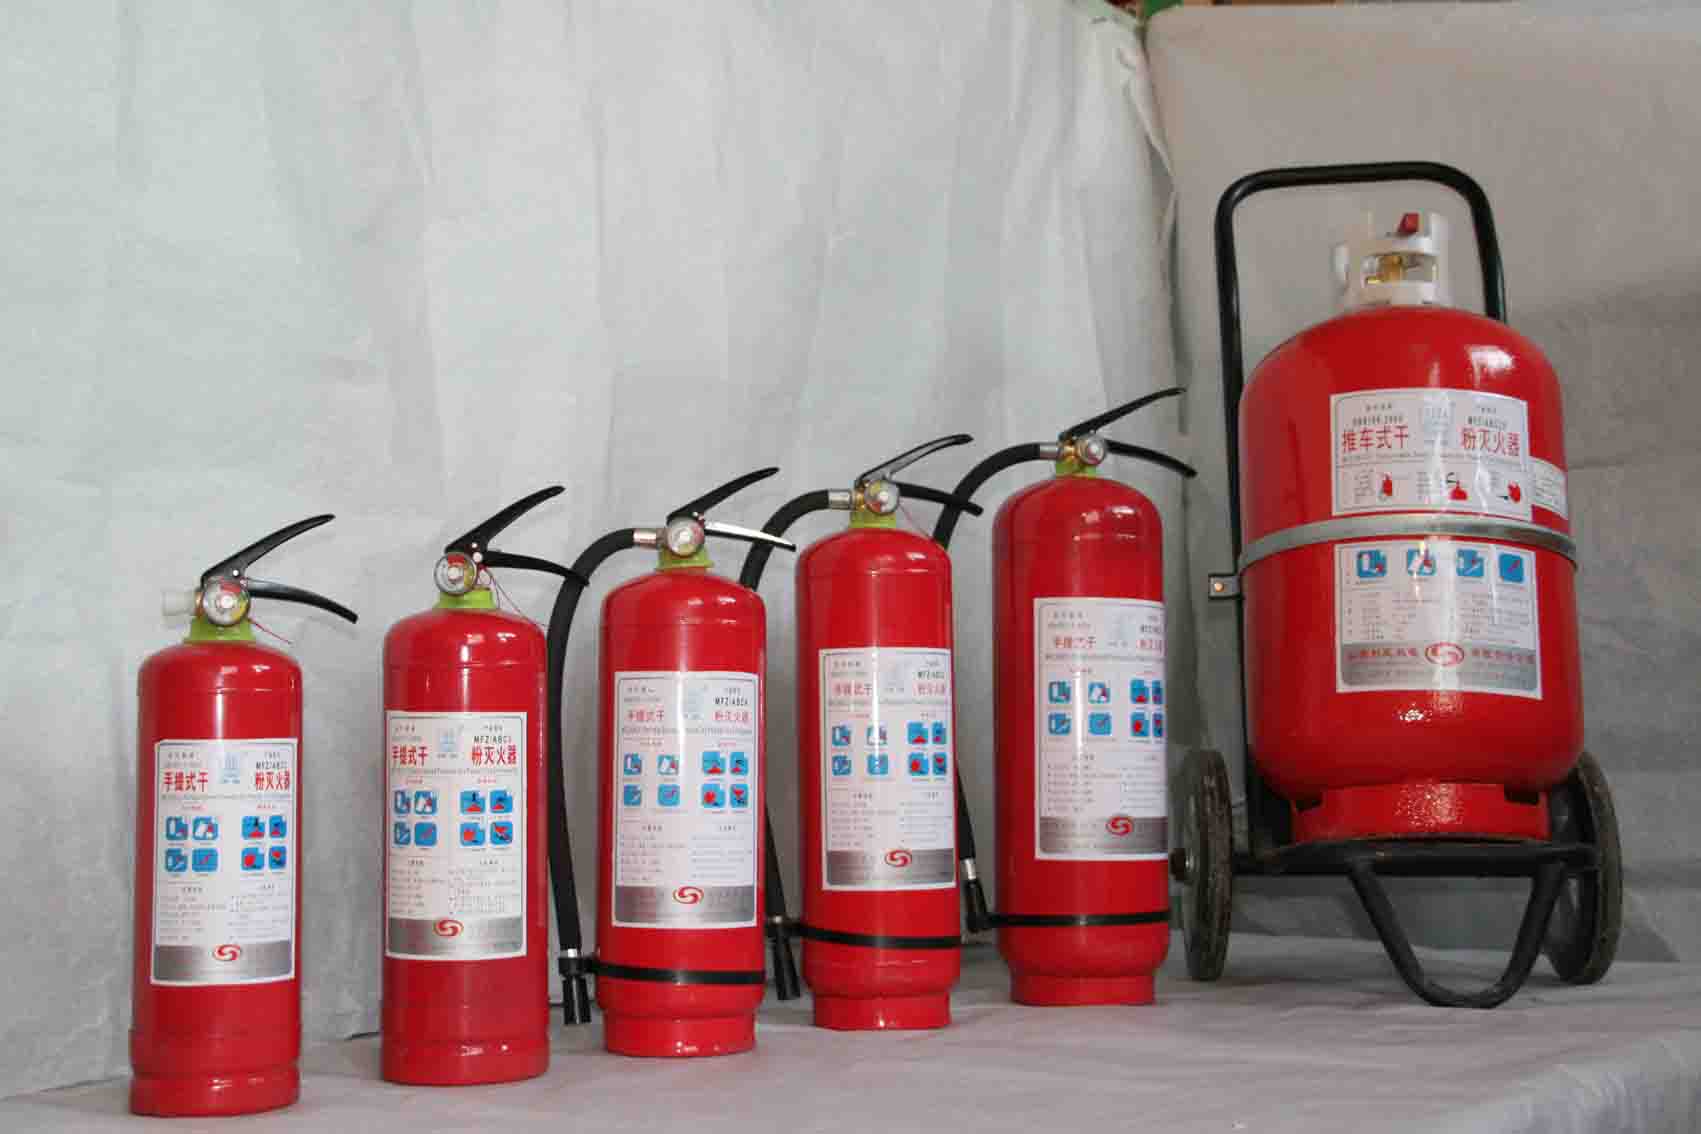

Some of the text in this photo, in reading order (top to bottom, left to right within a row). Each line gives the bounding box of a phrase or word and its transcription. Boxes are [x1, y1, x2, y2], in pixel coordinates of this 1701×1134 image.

[1341, 424, 1409, 454] 推车式干
[471, 745, 517, 766] 粉灭火器
